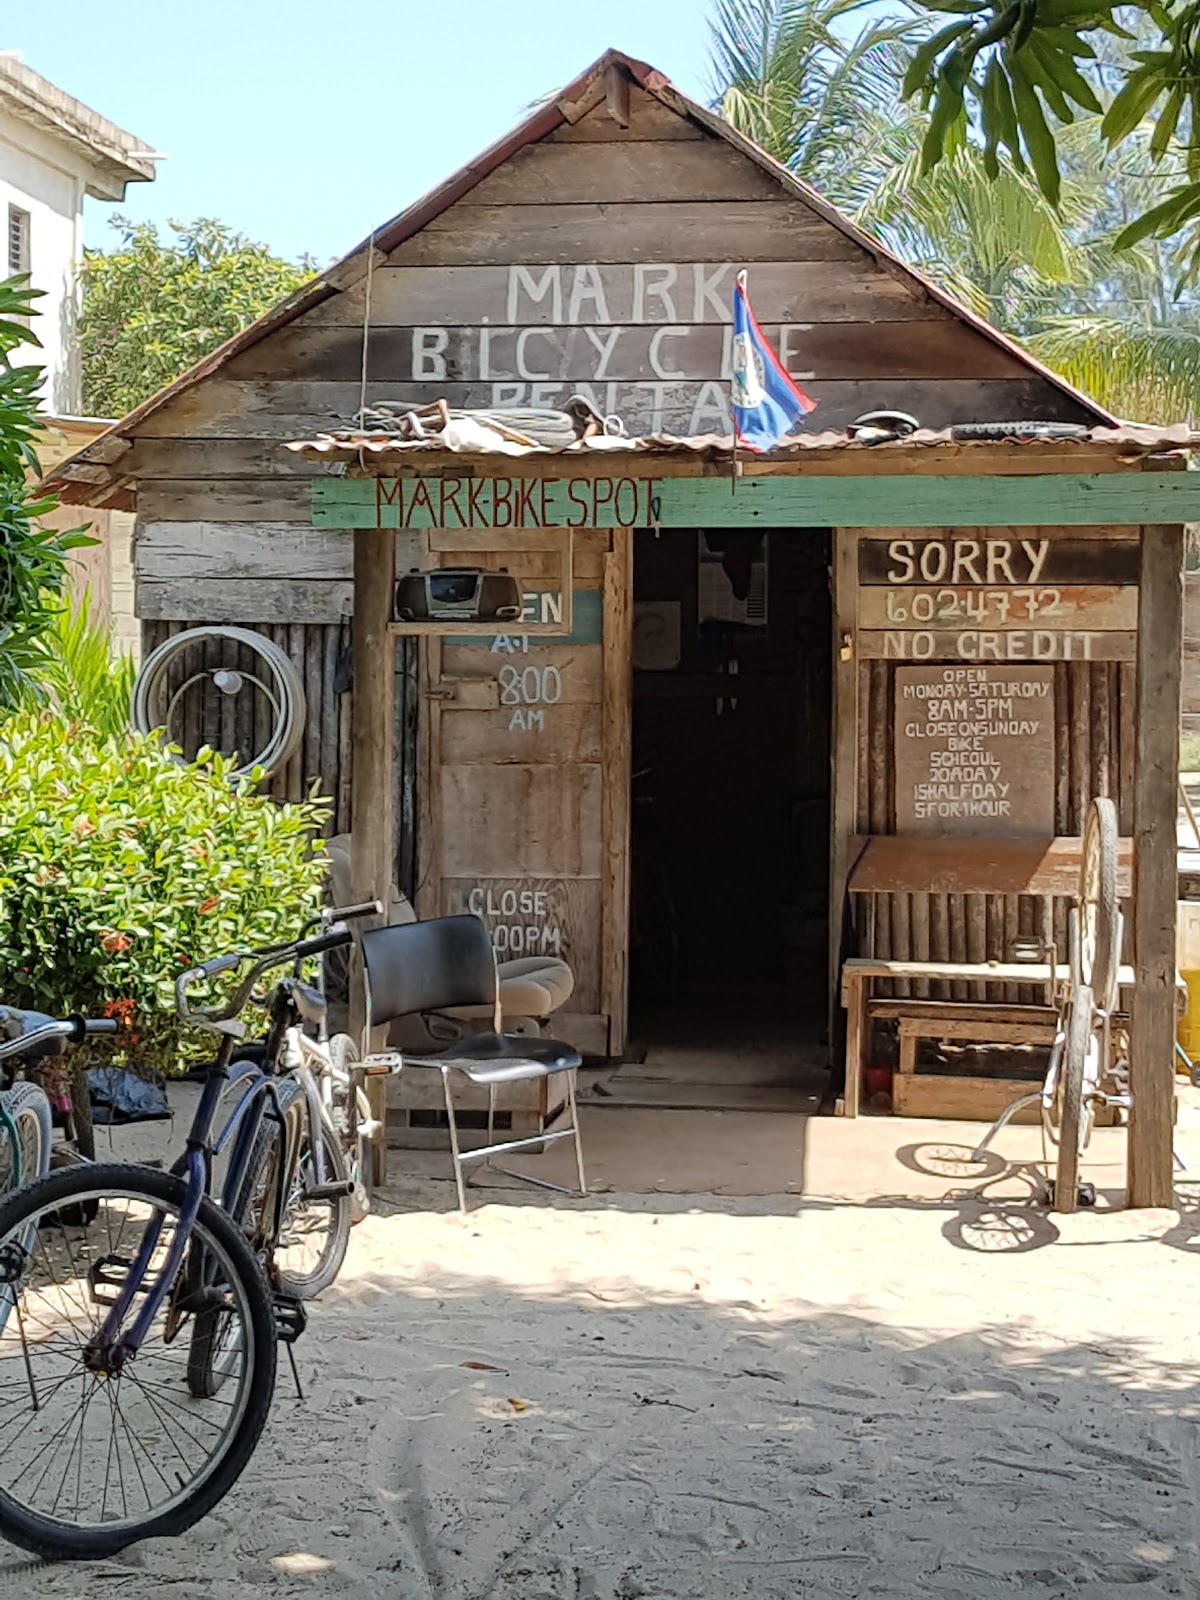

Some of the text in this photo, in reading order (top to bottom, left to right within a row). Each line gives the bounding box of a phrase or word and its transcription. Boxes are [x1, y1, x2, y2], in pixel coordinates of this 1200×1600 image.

[507, 263, 735, 324] MARK
[567, 477, 663, 528] SPOT
[887, 540, 1049, 584] SORRY
[517, 592, 563, 623] EN
[883, 631, 936, 660] NO
[943, 669, 987, 683] OPEN
[508, 709, 545, 732] AM
[468, 888, 548, 916] CLOSE
